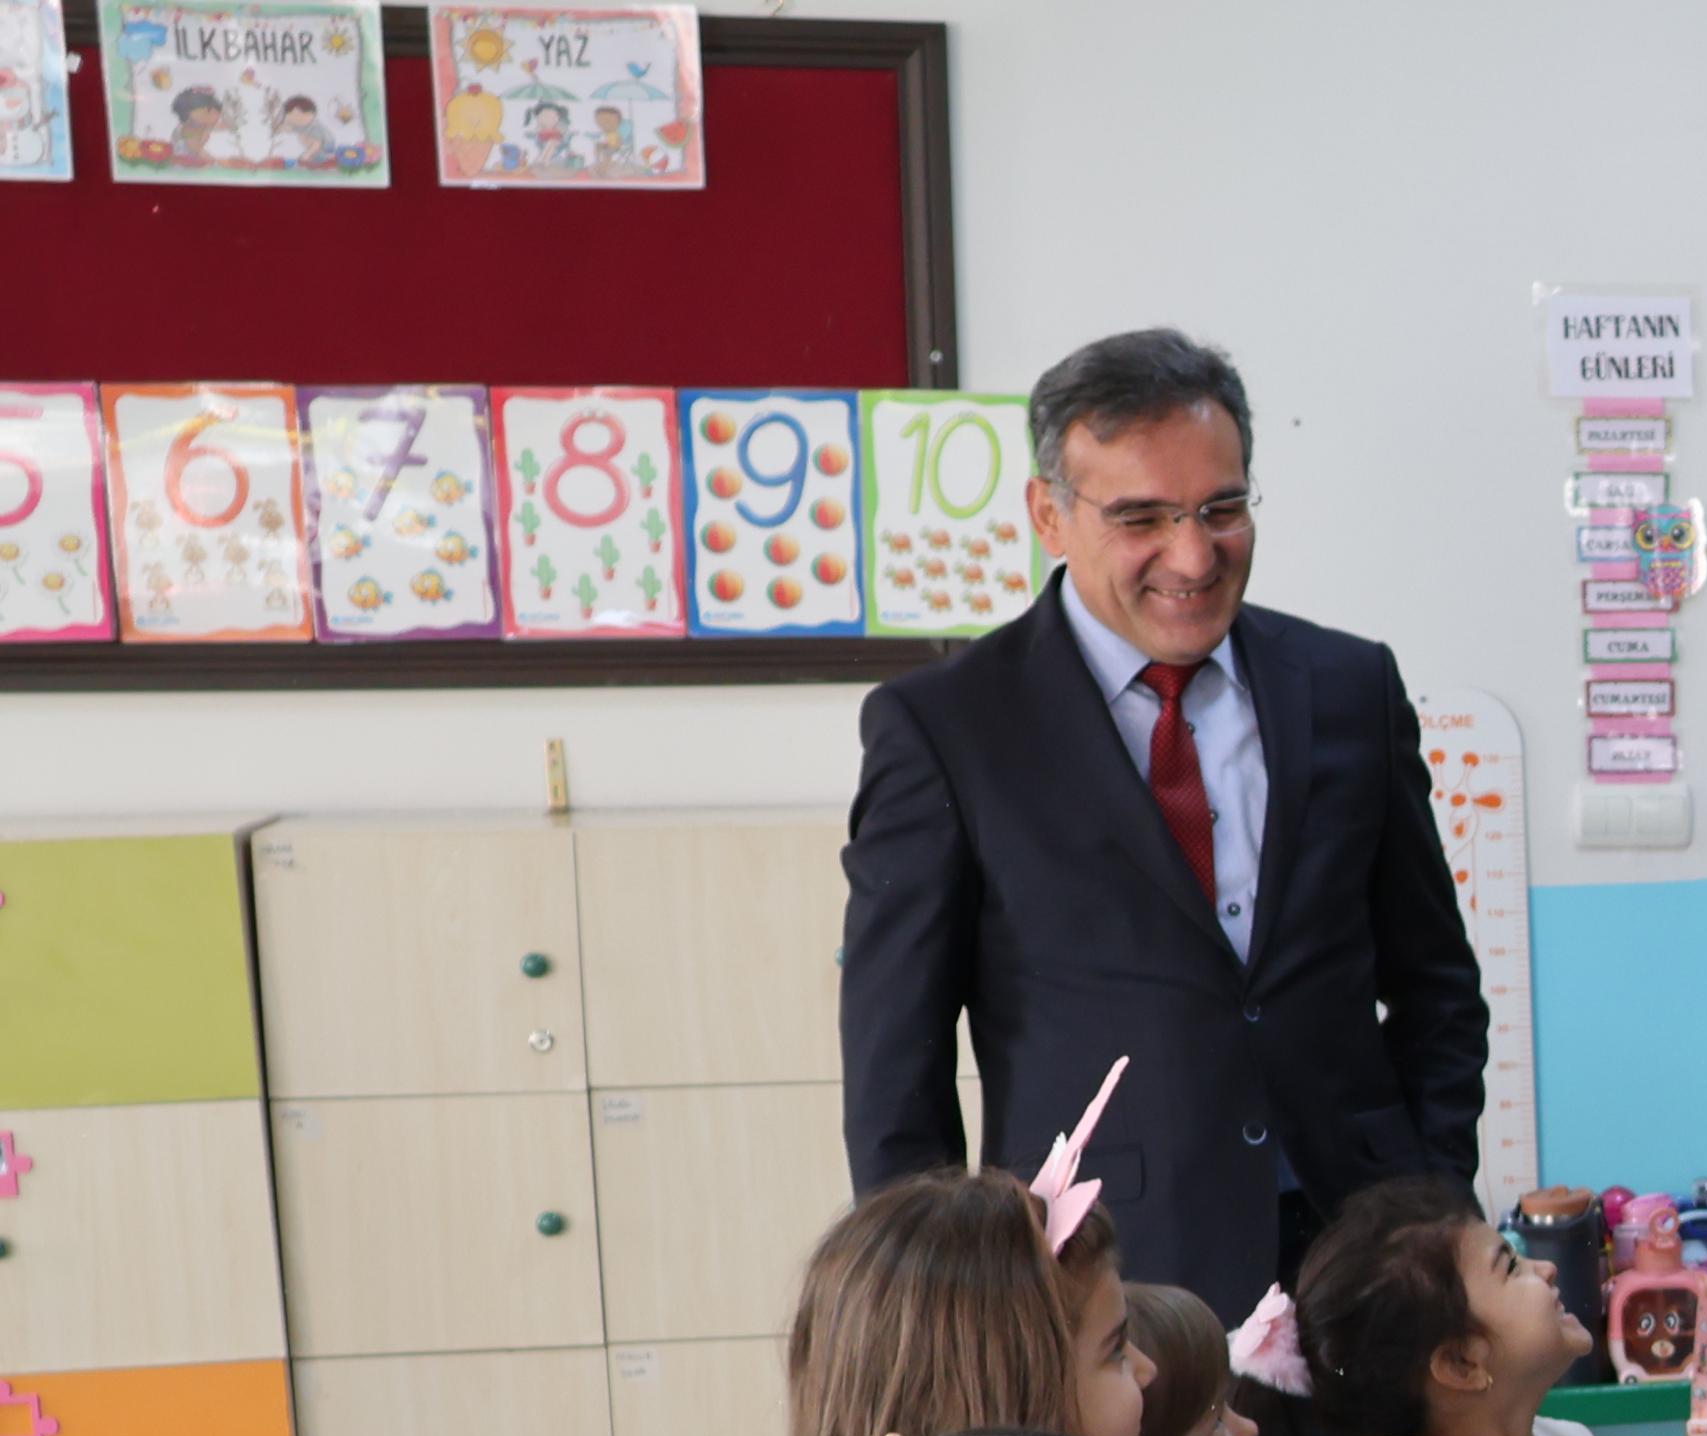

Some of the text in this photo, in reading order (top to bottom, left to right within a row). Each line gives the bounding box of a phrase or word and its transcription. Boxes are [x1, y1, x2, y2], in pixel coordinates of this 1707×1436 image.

[173, 20, 319, 65] İLKBAHAR
[538, 34, 592, 68] YAZ
[1563, 314, 1681, 339] HAFTANIN
[1580, 351, 1675, 380] GÜNLERİ
[164, 411, 250, 528] 6
[358, 407, 430, 522] 7
[543, 411, 632, 529] 8
[733, 411, 809, 529] 9
[899, 411, 1002, 522] 10
[1607, 640, 1649, 653] CUMA
